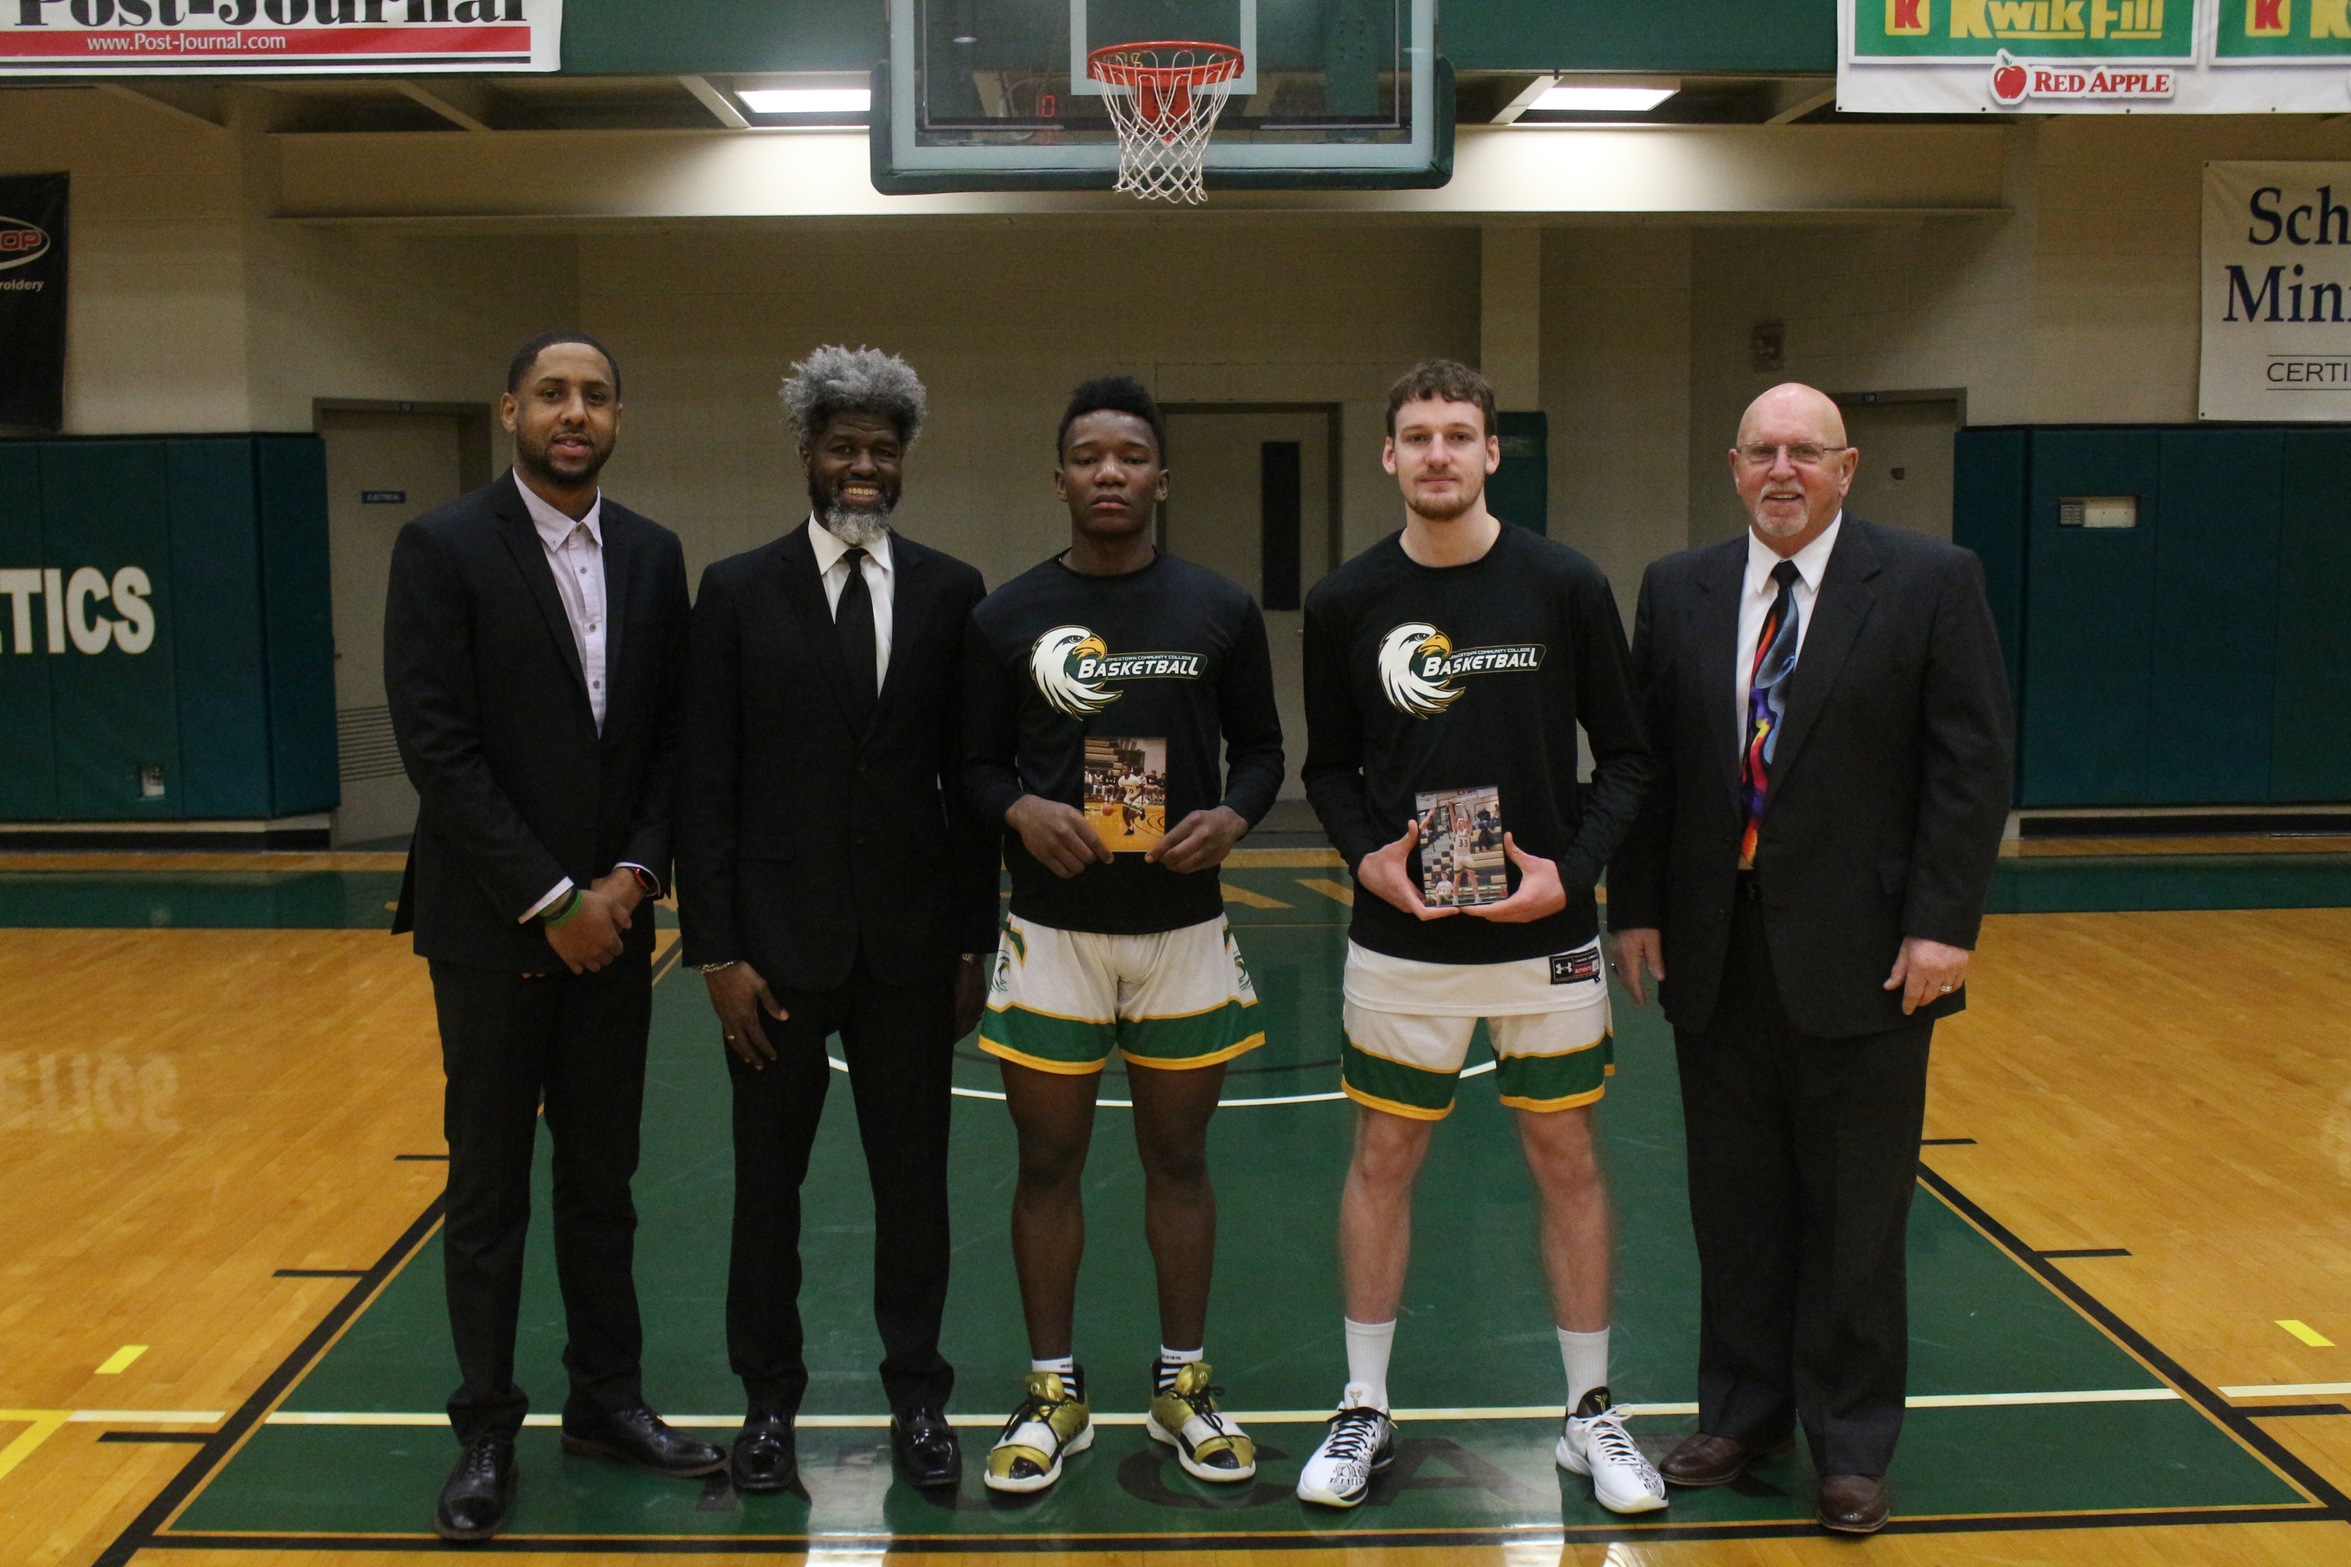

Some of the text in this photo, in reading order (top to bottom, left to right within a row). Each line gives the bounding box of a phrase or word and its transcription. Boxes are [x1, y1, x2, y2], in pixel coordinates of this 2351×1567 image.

[87, 33, 286, 52] www.Post-Journal.com
[2033, 71, 2170, 93] RED APPLE
[2248, 184, 2351, 245] Sch
[0, 230, 41, 251] OP
[2222, 264, 2351, 323] Min
[0, 566, 156, 655] TICS
[1078, 657, 1199, 679] BASKETBALL
[1423, 648, 1537, 677] BASKETBALL
